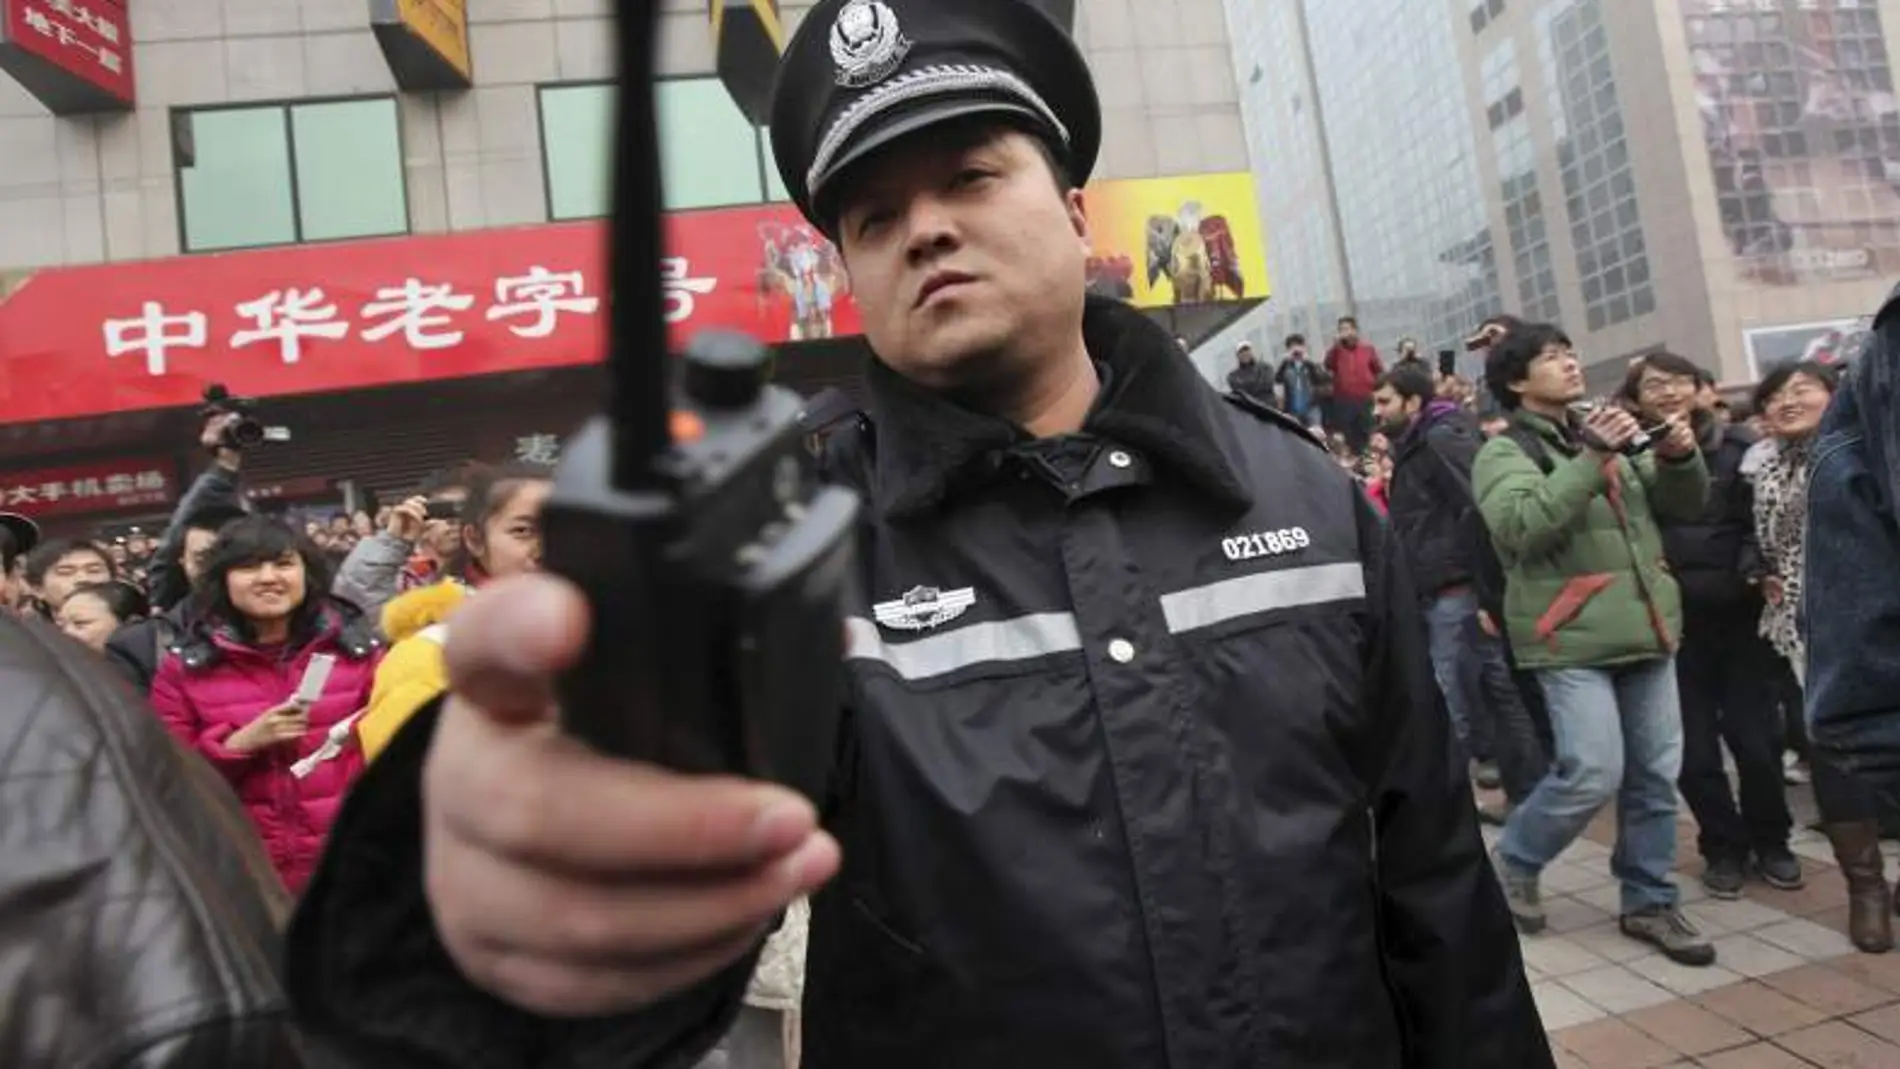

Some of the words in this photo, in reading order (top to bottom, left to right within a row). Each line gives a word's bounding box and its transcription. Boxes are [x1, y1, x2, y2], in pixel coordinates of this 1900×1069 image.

[103, 256, 717, 375] 中华老字号
[0, 470, 164, 505] 大手机卖场
[1222, 527, 1310, 559] 021869
